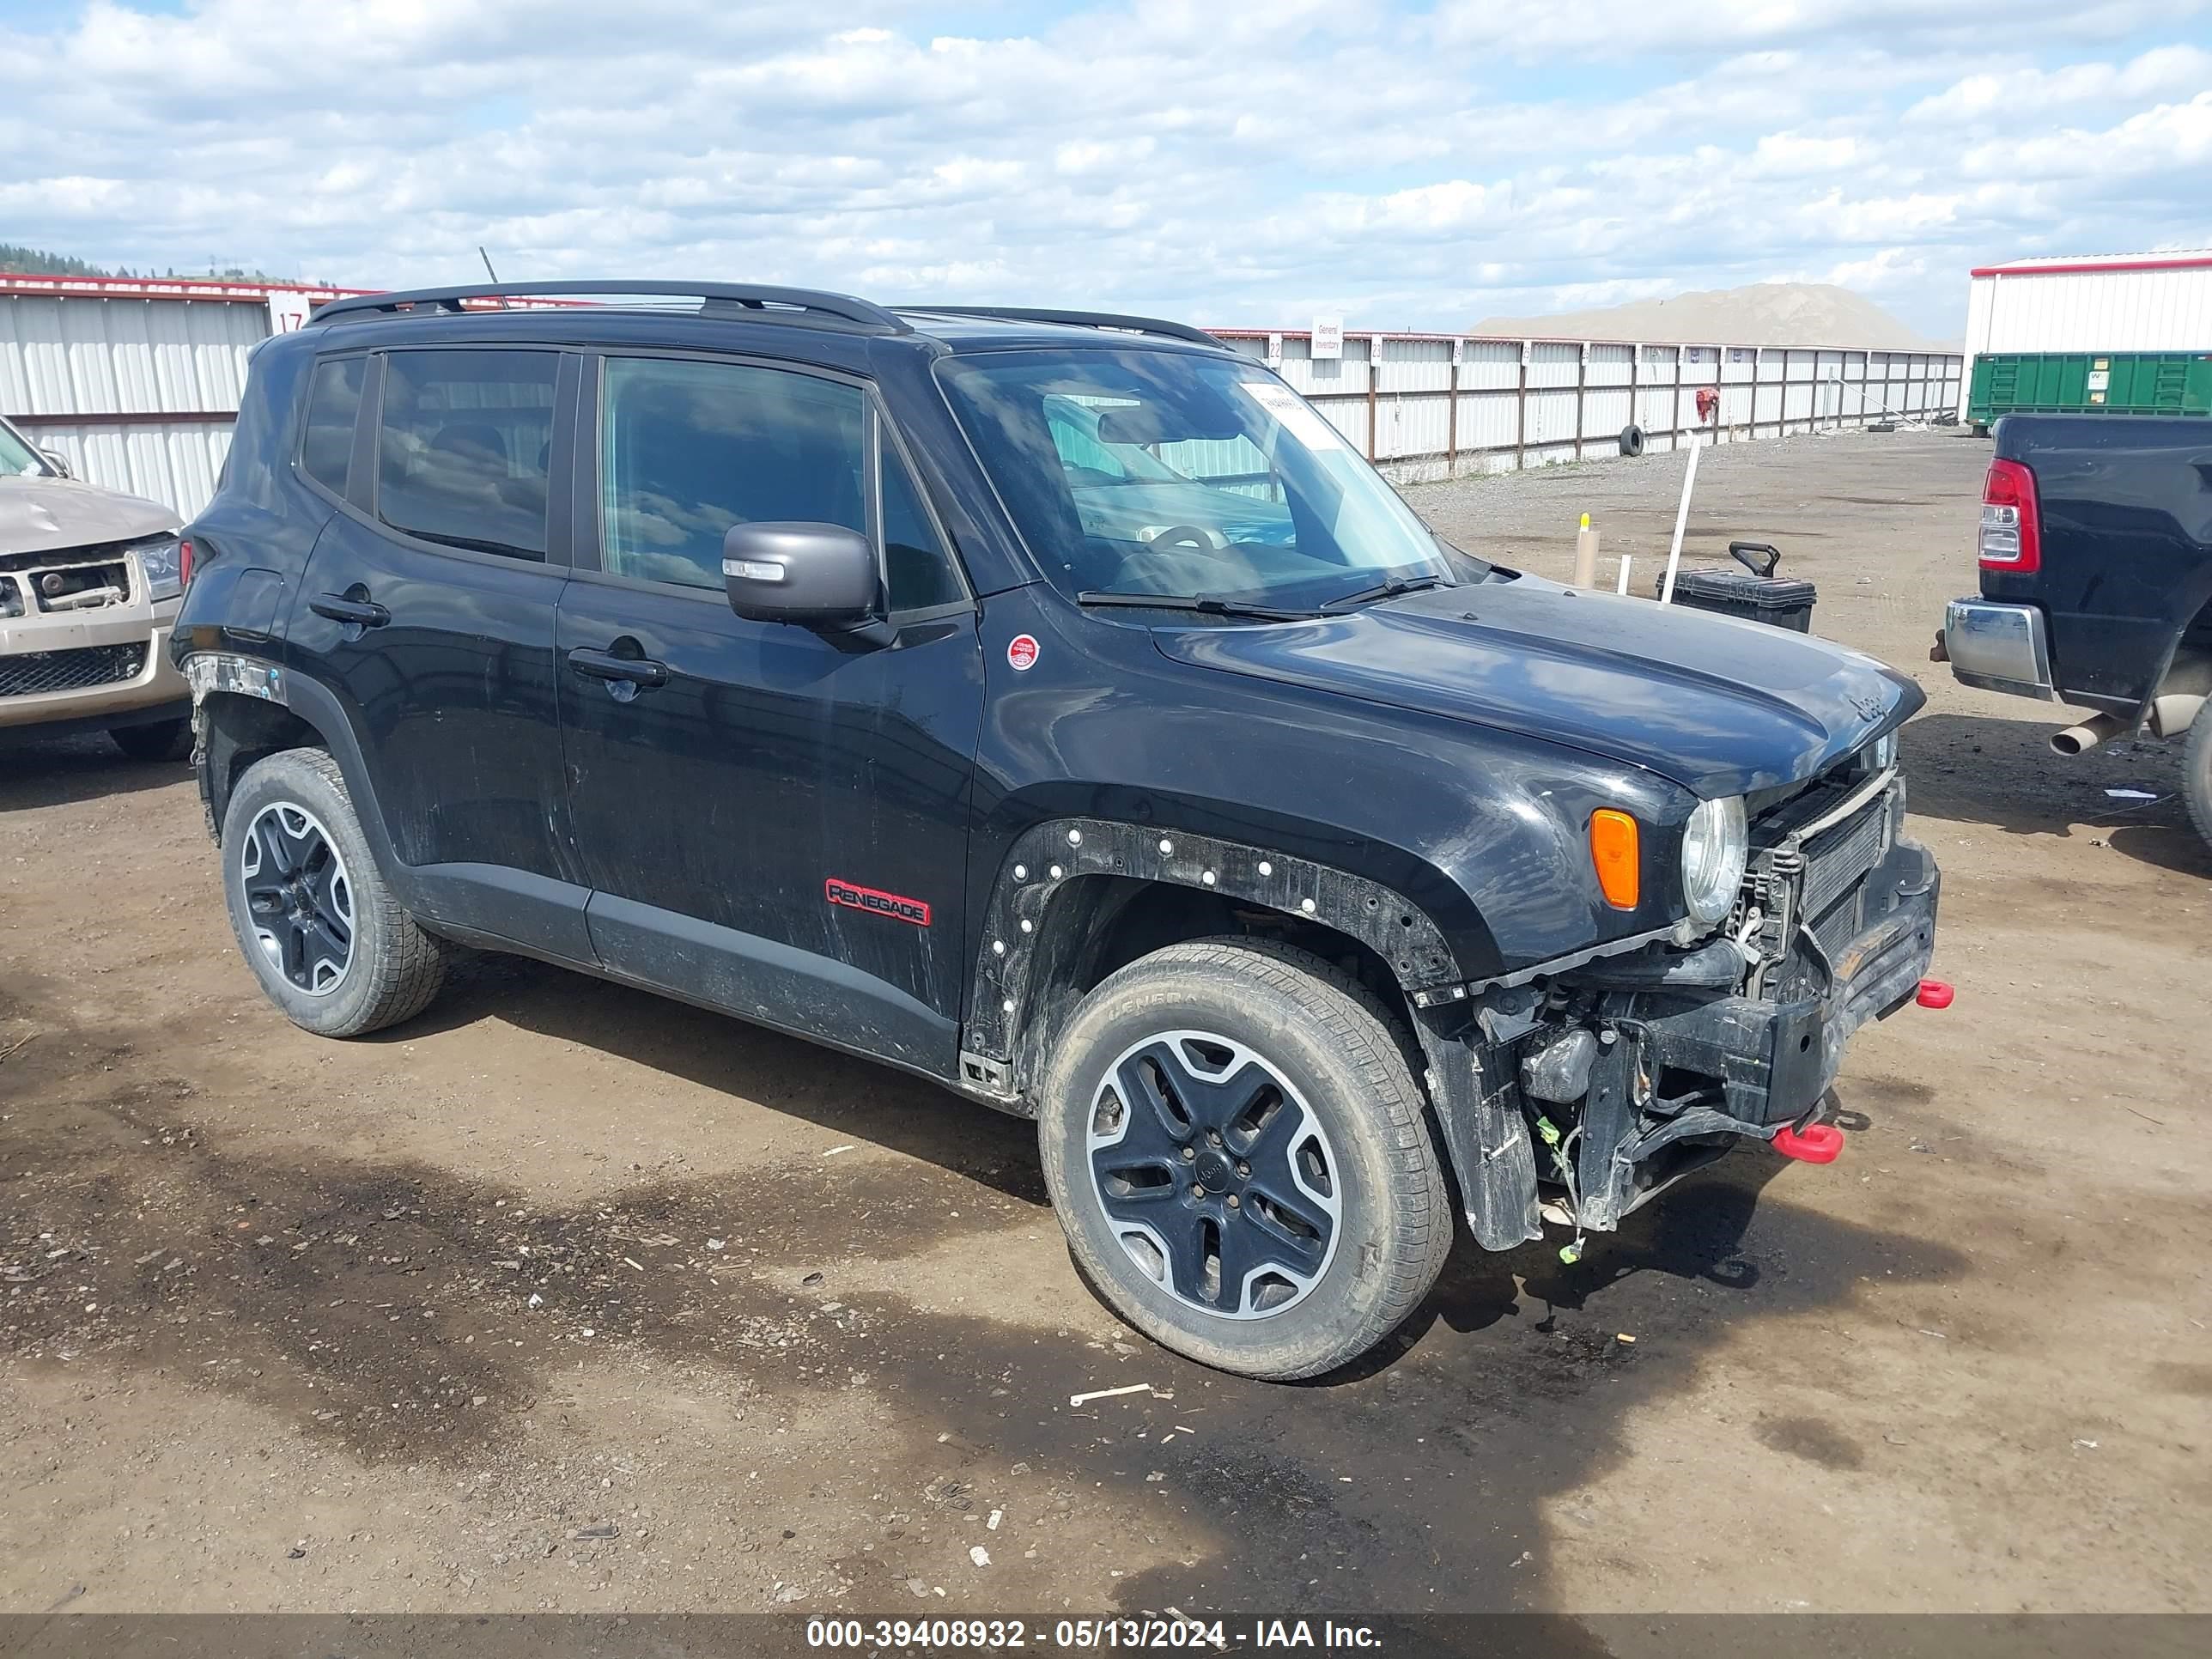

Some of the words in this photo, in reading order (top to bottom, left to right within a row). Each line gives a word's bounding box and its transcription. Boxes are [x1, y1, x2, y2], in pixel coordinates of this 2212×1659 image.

[280, 313, 302, 332] 17
[1318, 325, 1339, 335] General
[1270, 343, 1280, 358] 22
[1316, 339, 1340, 350] Inventory
[1372, 343, 1381, 358] 23
[1454, 345, 1462, 358] 24
[1849, 696, 1887, 722] Jeep
[828, 884, 926, 921] RENEGADE
[1201, 1163, 1223, 1182] Jeep
